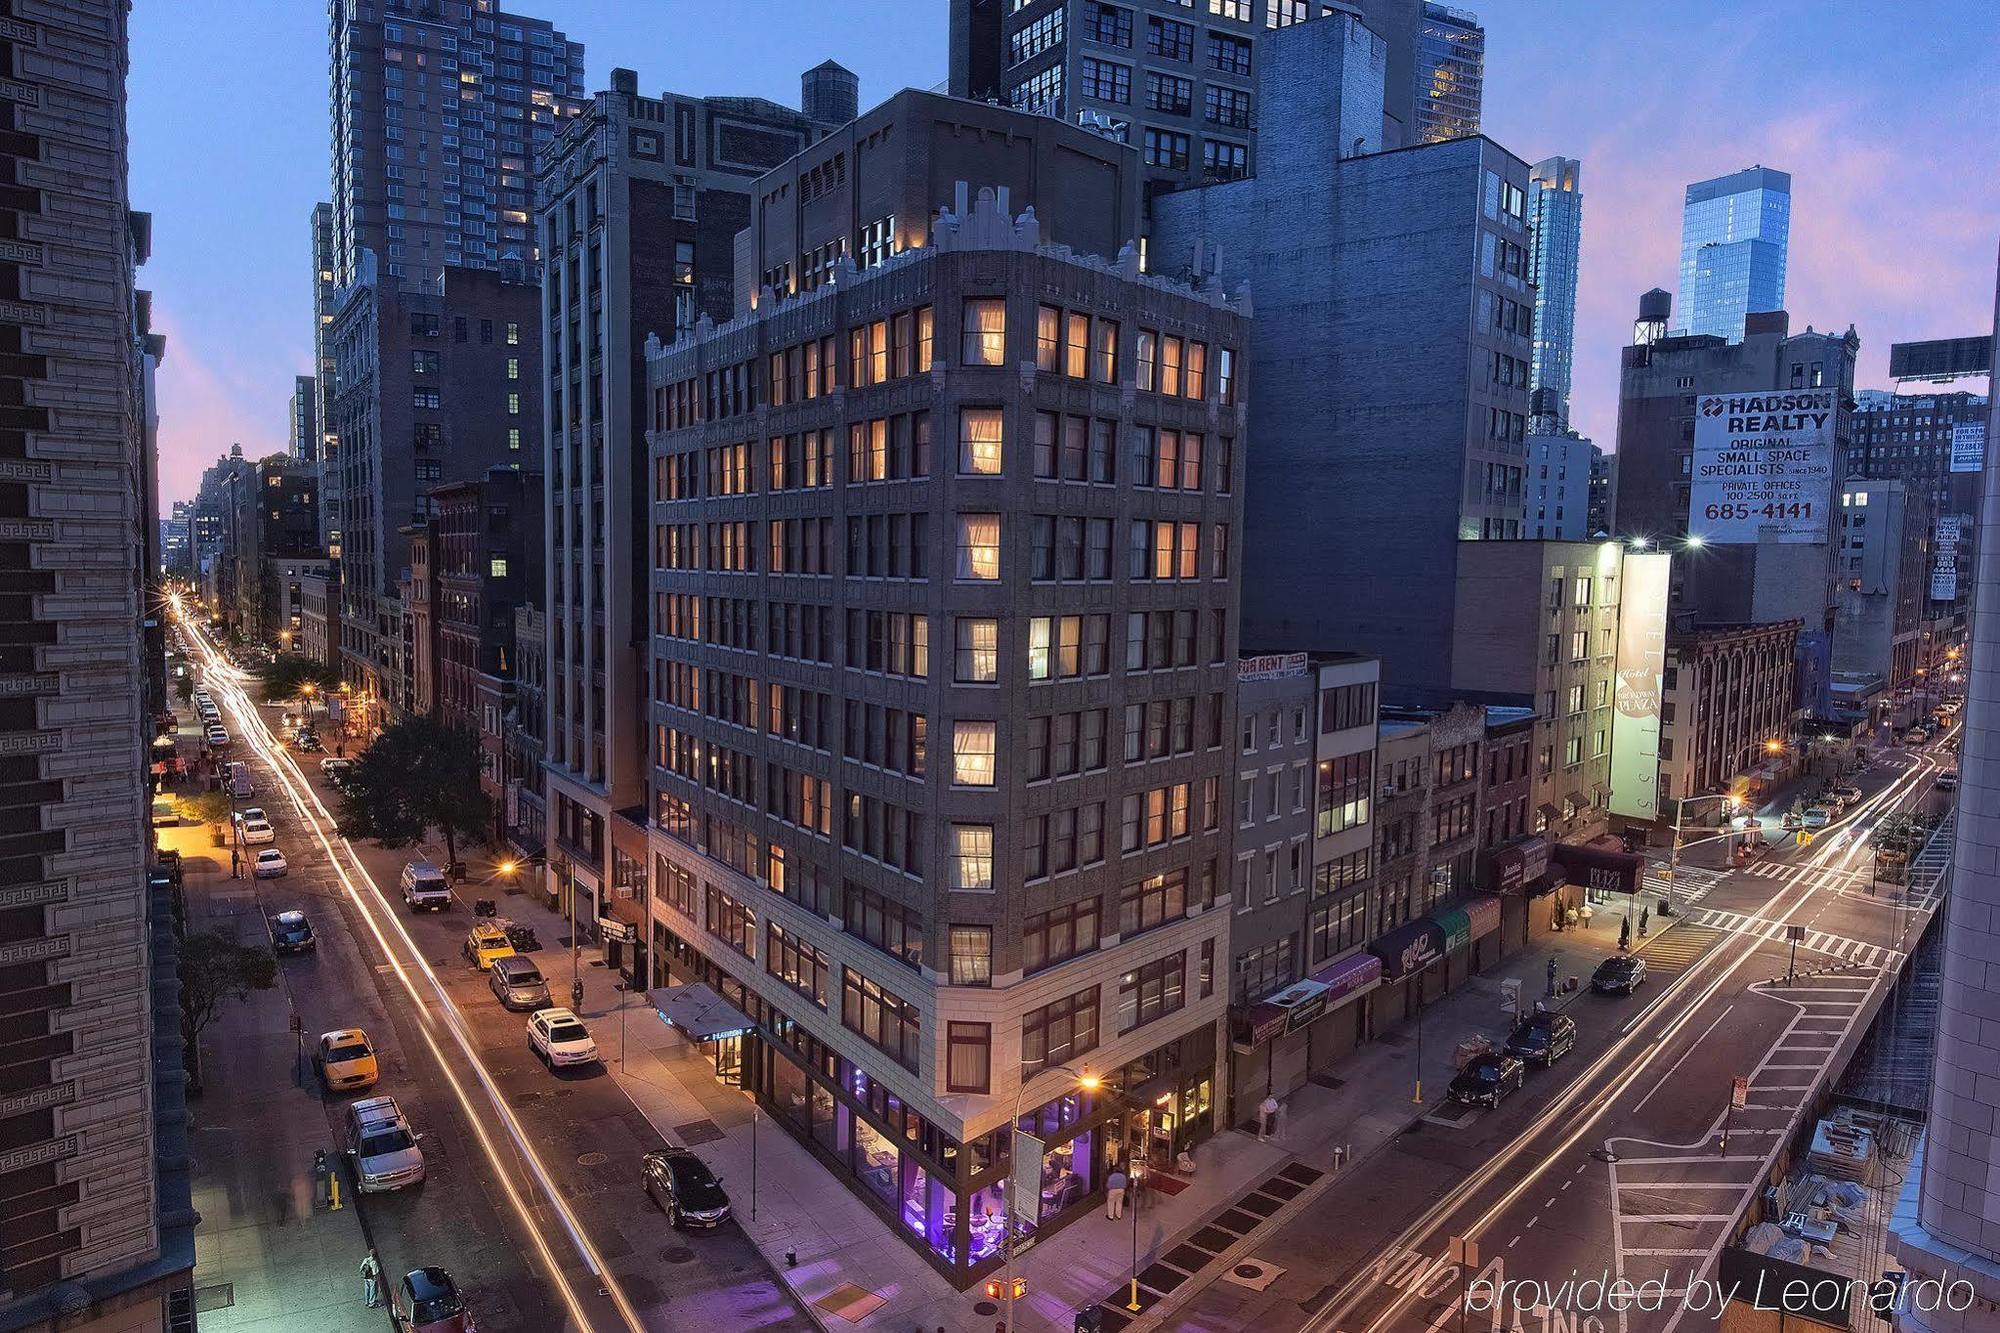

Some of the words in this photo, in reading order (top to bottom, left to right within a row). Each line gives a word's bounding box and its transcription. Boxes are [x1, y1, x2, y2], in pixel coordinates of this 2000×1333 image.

[1729, 393, 1831, 414] HADSON
[1728, 413, 1829, 433] REALTY
[1730, 438, 1792, 450] ORIGINAL
[1717, 451, 1761, 464] SMALL
[1768, 450, 1811, 462] SPACE
[1700, 464, 1784, 476] SPECIALISTS
[1722, 482, 1758, 491] PRIVATE
[1763, 481, 1801, 490] OFFICES
[1705, 502, 1812, 520] 685-4141
[1259, 657, 1283, 672] RENT
[1618, 668, 1649, 680] Hotel
[1618, 699, 1658, 712] PLAZA
